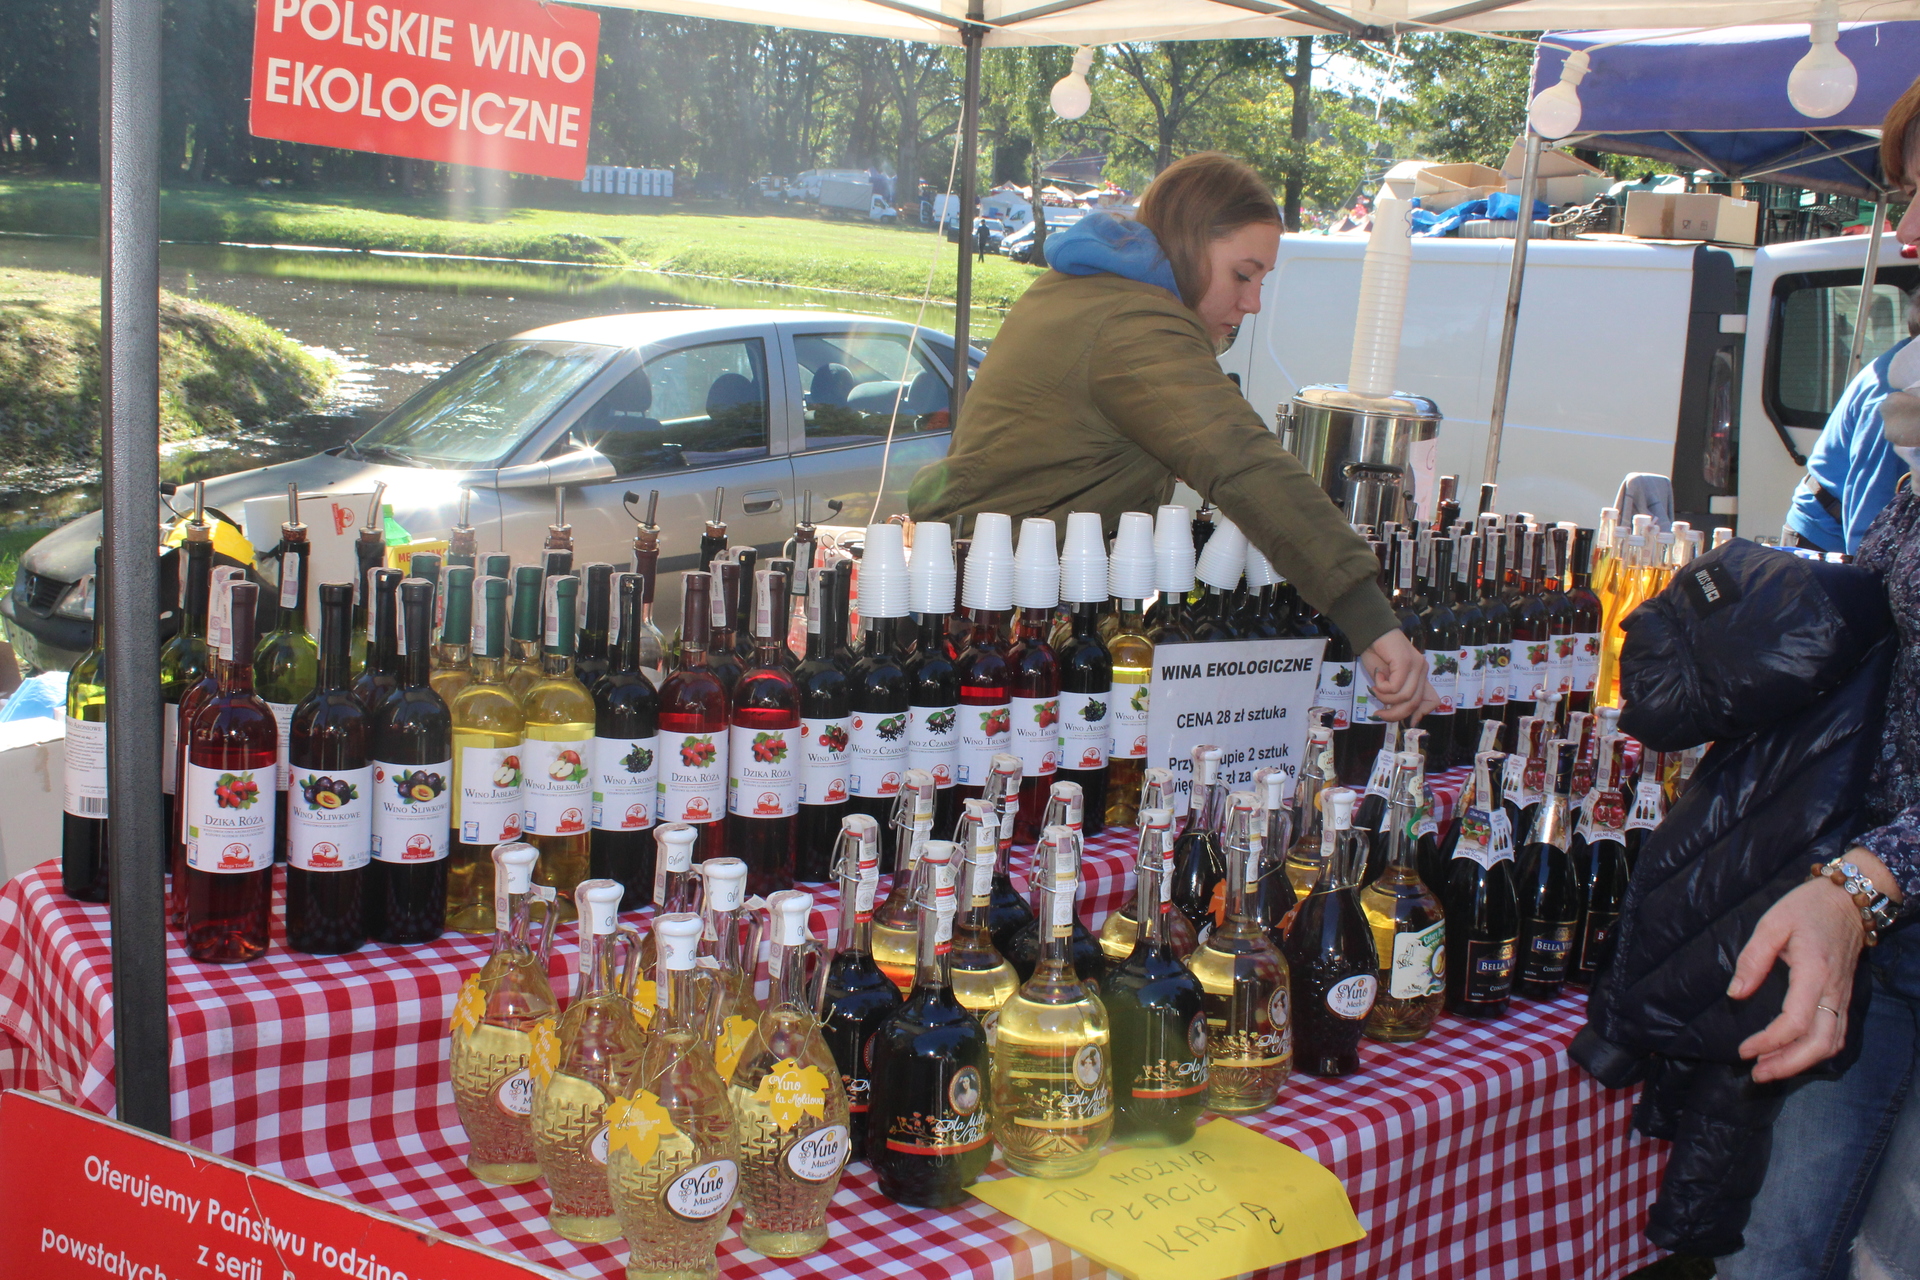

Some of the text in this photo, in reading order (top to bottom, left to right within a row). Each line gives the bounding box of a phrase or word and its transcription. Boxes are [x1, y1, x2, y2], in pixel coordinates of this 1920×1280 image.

[272, 0, 586, 84] POLSKIE WINO
[265, 57, 582, 148] EKOLOGICZNE
[1161, 658, 1314, 681] WINA EKOLOGICZNE
[1115, 712, 1134, 720] WINO
[1176, 705, 1288, 729] CENA 28 zł sztuka
[1017, 728, 1037, 737] WINO
[1064, 722, 1084, 731] WINO
[851, 744, 872, 754] WINO
[963, 737, 983, 746] WINO
[808, 753, 830, 762] WINO
[1169, 757, 1194, 773] Przy
[1248, 747, 1255, 761] 2
[1258, 743, 1289, 760] sztuk
[603, 774, 627, 785] WINO
[671, 772, 720, 782] DZIKA RÓŻA
[743, 767, 792, 778] DZIKA RÓŻA
[1226, 770, 1236, 785] zł
[1238, 772, 1252, 783] za
[525, 779, 546, 791] WINO
[464, 788, 490, 799] WINO
[293, 806, 361, 821] WINO ŚLIWKOWE
[383, 802, 408, 814] WINO
[205, 814, 265, 827] DZIKA RÓŻA
[1536, 940, 1561, 951] BELLA
[1481, 962, 1506, 971] BELLA
[1337, 977, 1368, 999] Vino
[768, 1071, 802, 1091] Vino
[775, 1092, 825, 1108] la Moldova
[782, 1112, 789, 1120] A
[935, 1115, 966, 1133] Dla
[801, 1130, 839, 1159] Vino
[811, 1157, 836, 1169] Muscat
[681, 1165, 724, 1196] Vino
[1043, 1147, 1216, 1208] TU MOŻNA
[84, 1155, 201, 1224] Oferujemy
[207, 1197, 306, 1257] Państwu
[693, 1192, 723, 1207] Muscat
[1089, 1173, 1218, 1229] PŁACIĆ
[1142, 1200, 1286, 1261] KARTĄ
[41, 1227, 168, 1280] powstałych
[197, 1244, 209, 1267] z
[215, 1251, 263, 1280] serii
